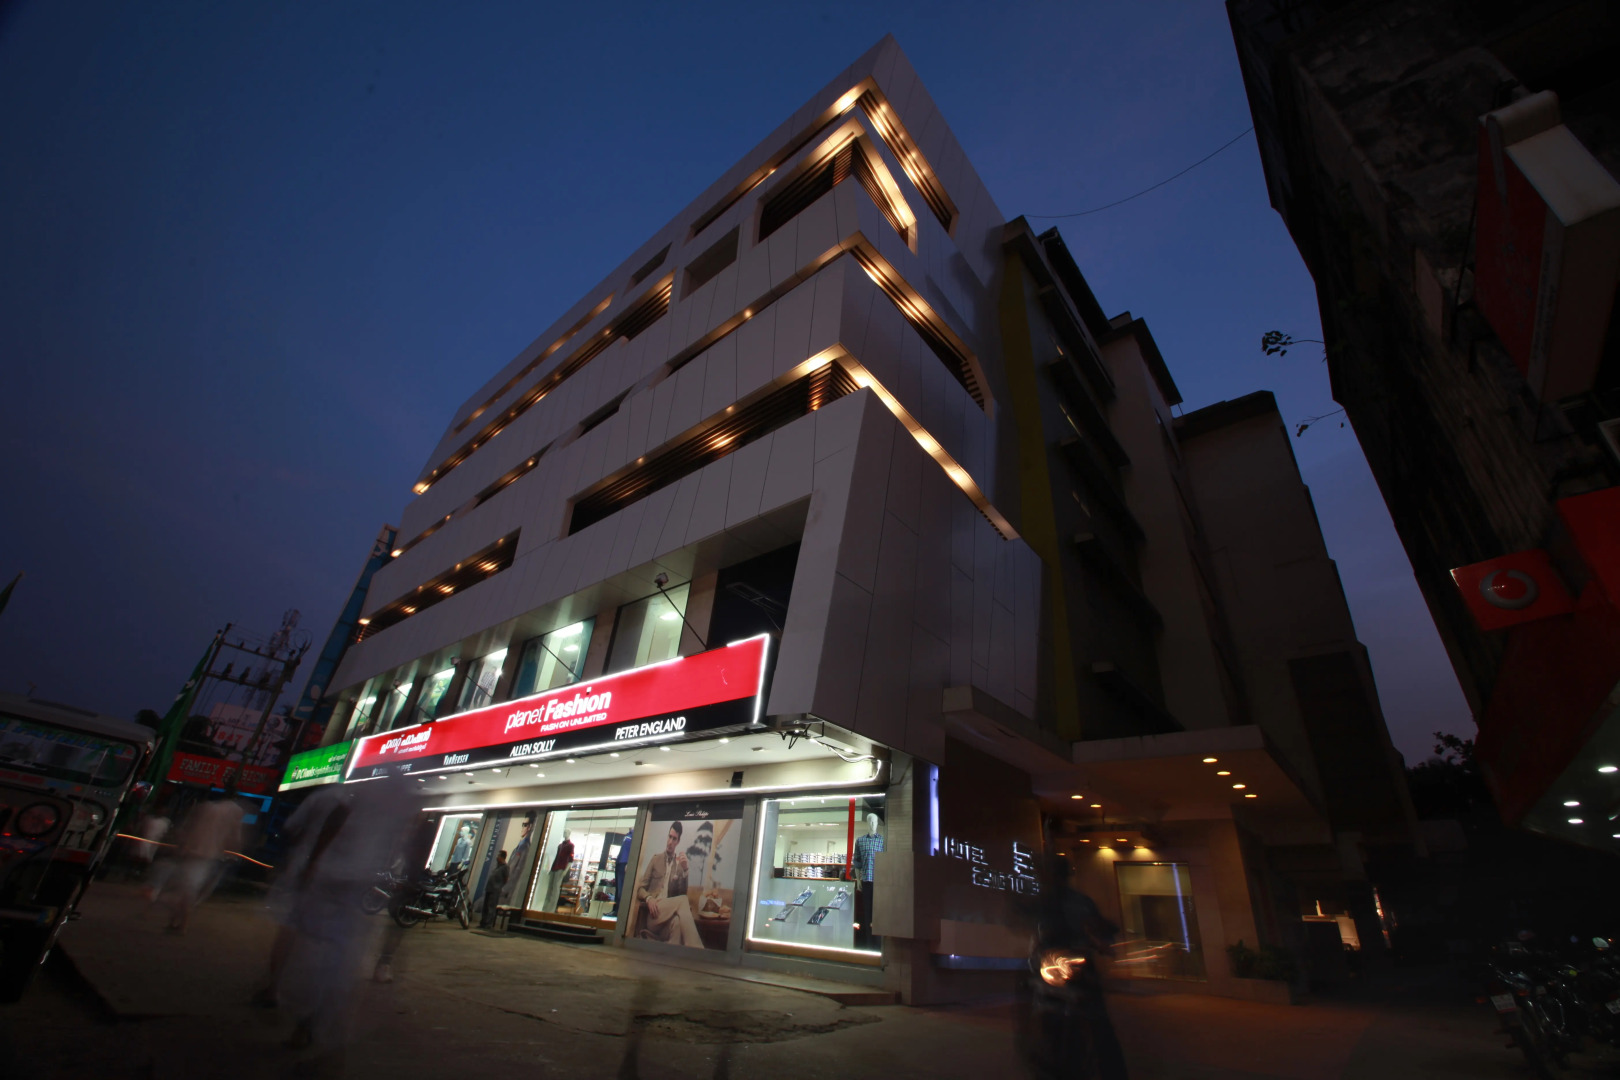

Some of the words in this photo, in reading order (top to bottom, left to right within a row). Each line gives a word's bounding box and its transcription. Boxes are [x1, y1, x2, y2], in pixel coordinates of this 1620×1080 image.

[504, 705, 546, 734] planet
[544, 686, 612, 722] Fashion
[570, 712, 607, 727] UNLIMITED
[615, 724, 640, 741] PETER
[639, 716, 686, 737] ENGLAND
[509, 744, 534, 758] ALLEN
[531, 739, 557, 755] SOLLY
[179, 758, 220, 775] FAMILY
